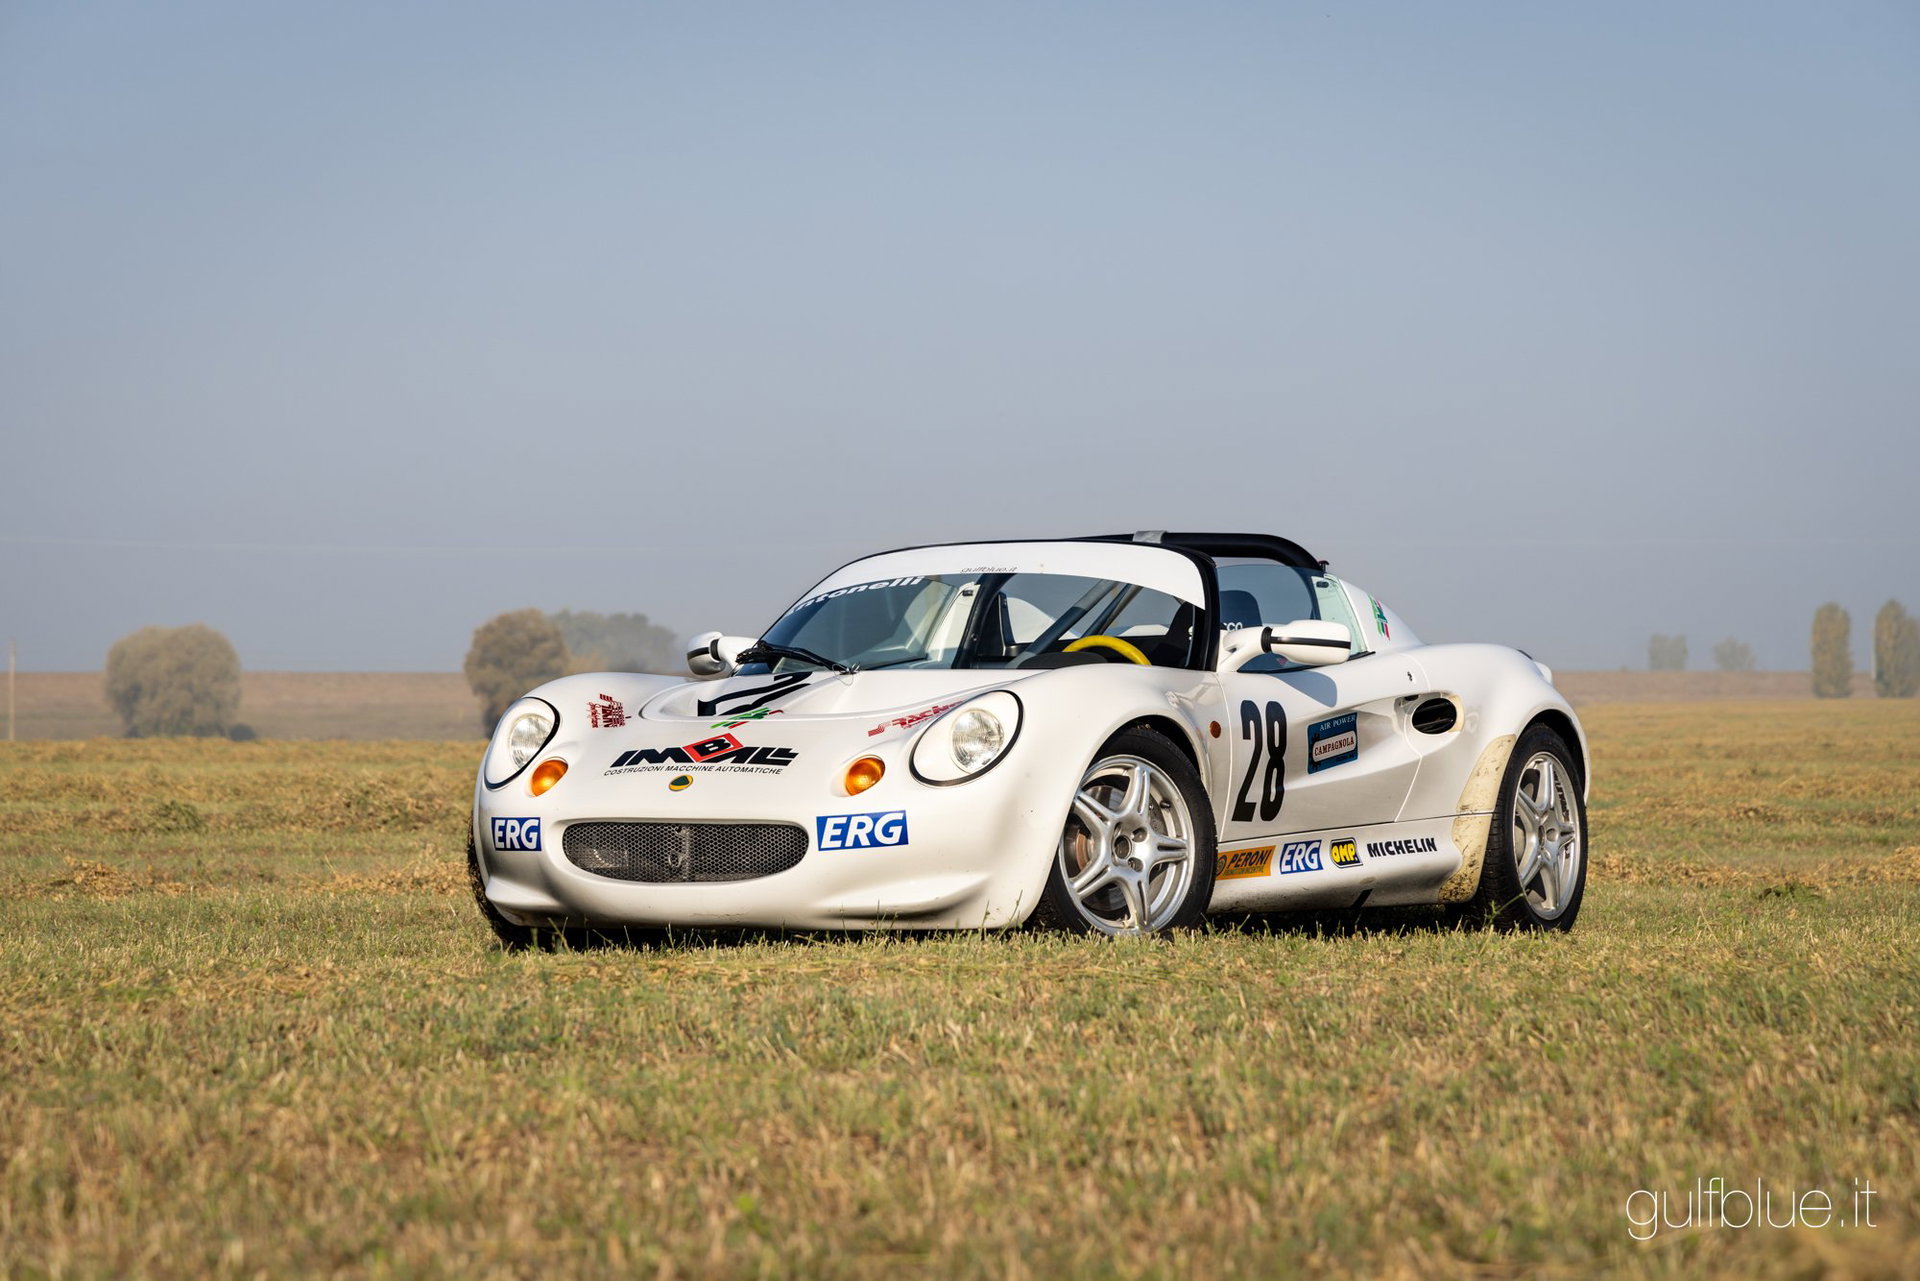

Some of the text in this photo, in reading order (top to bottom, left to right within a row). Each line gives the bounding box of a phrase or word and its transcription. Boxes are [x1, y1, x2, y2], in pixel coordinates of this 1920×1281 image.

[1319, 714, 1356, 731] AIR POWER
[1314, 736, 1355, 757] CAMPAGNOLA
[603, 765, 783, 776] COSTRUZIONI MACCHINE AUTOMATICHE
[1231, 699, 1287, 822] 28
[494, 818, 540, 850] ERG
[820, 812, 905, 849] ERG
[1281, 841, 1321, 873] ERG
[1331, 843, 1357, 863] OMP
[1366, 837, 1438, 858] MICHELIN
[1226, 849, 1272, 869] PERONI
